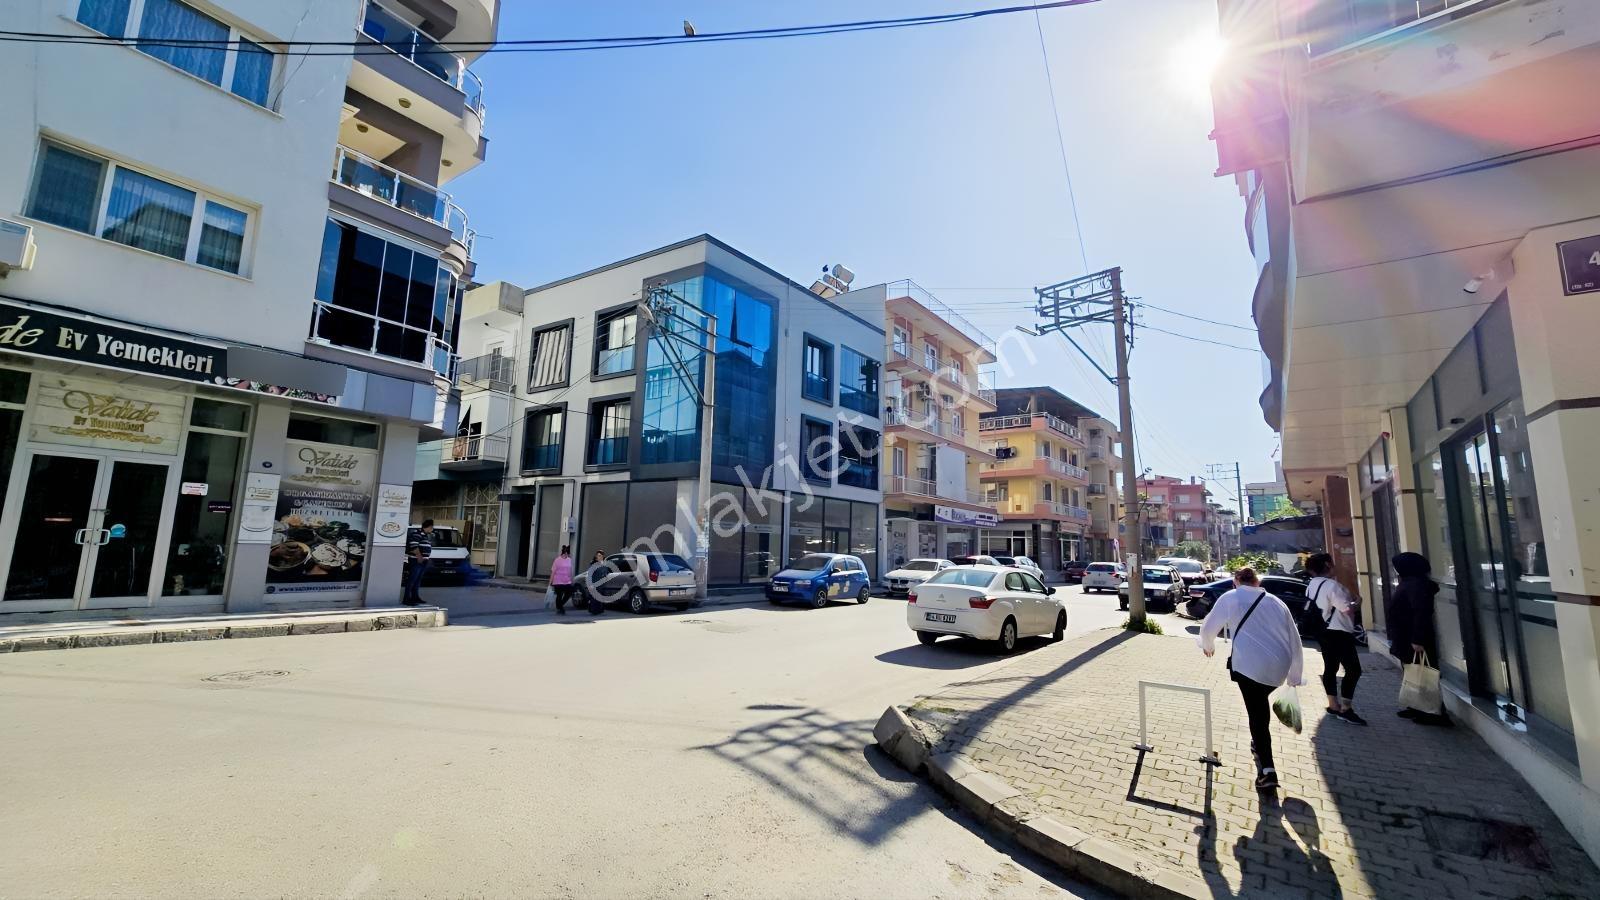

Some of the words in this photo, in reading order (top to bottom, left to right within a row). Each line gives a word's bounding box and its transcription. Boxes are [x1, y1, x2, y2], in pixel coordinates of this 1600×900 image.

[56, 327, 88, 351] Ev
[96, 333, 214, 374] Yemekleri
[62, 390, 160, 423] Valide
[298, 447, 359, 470] Valide
